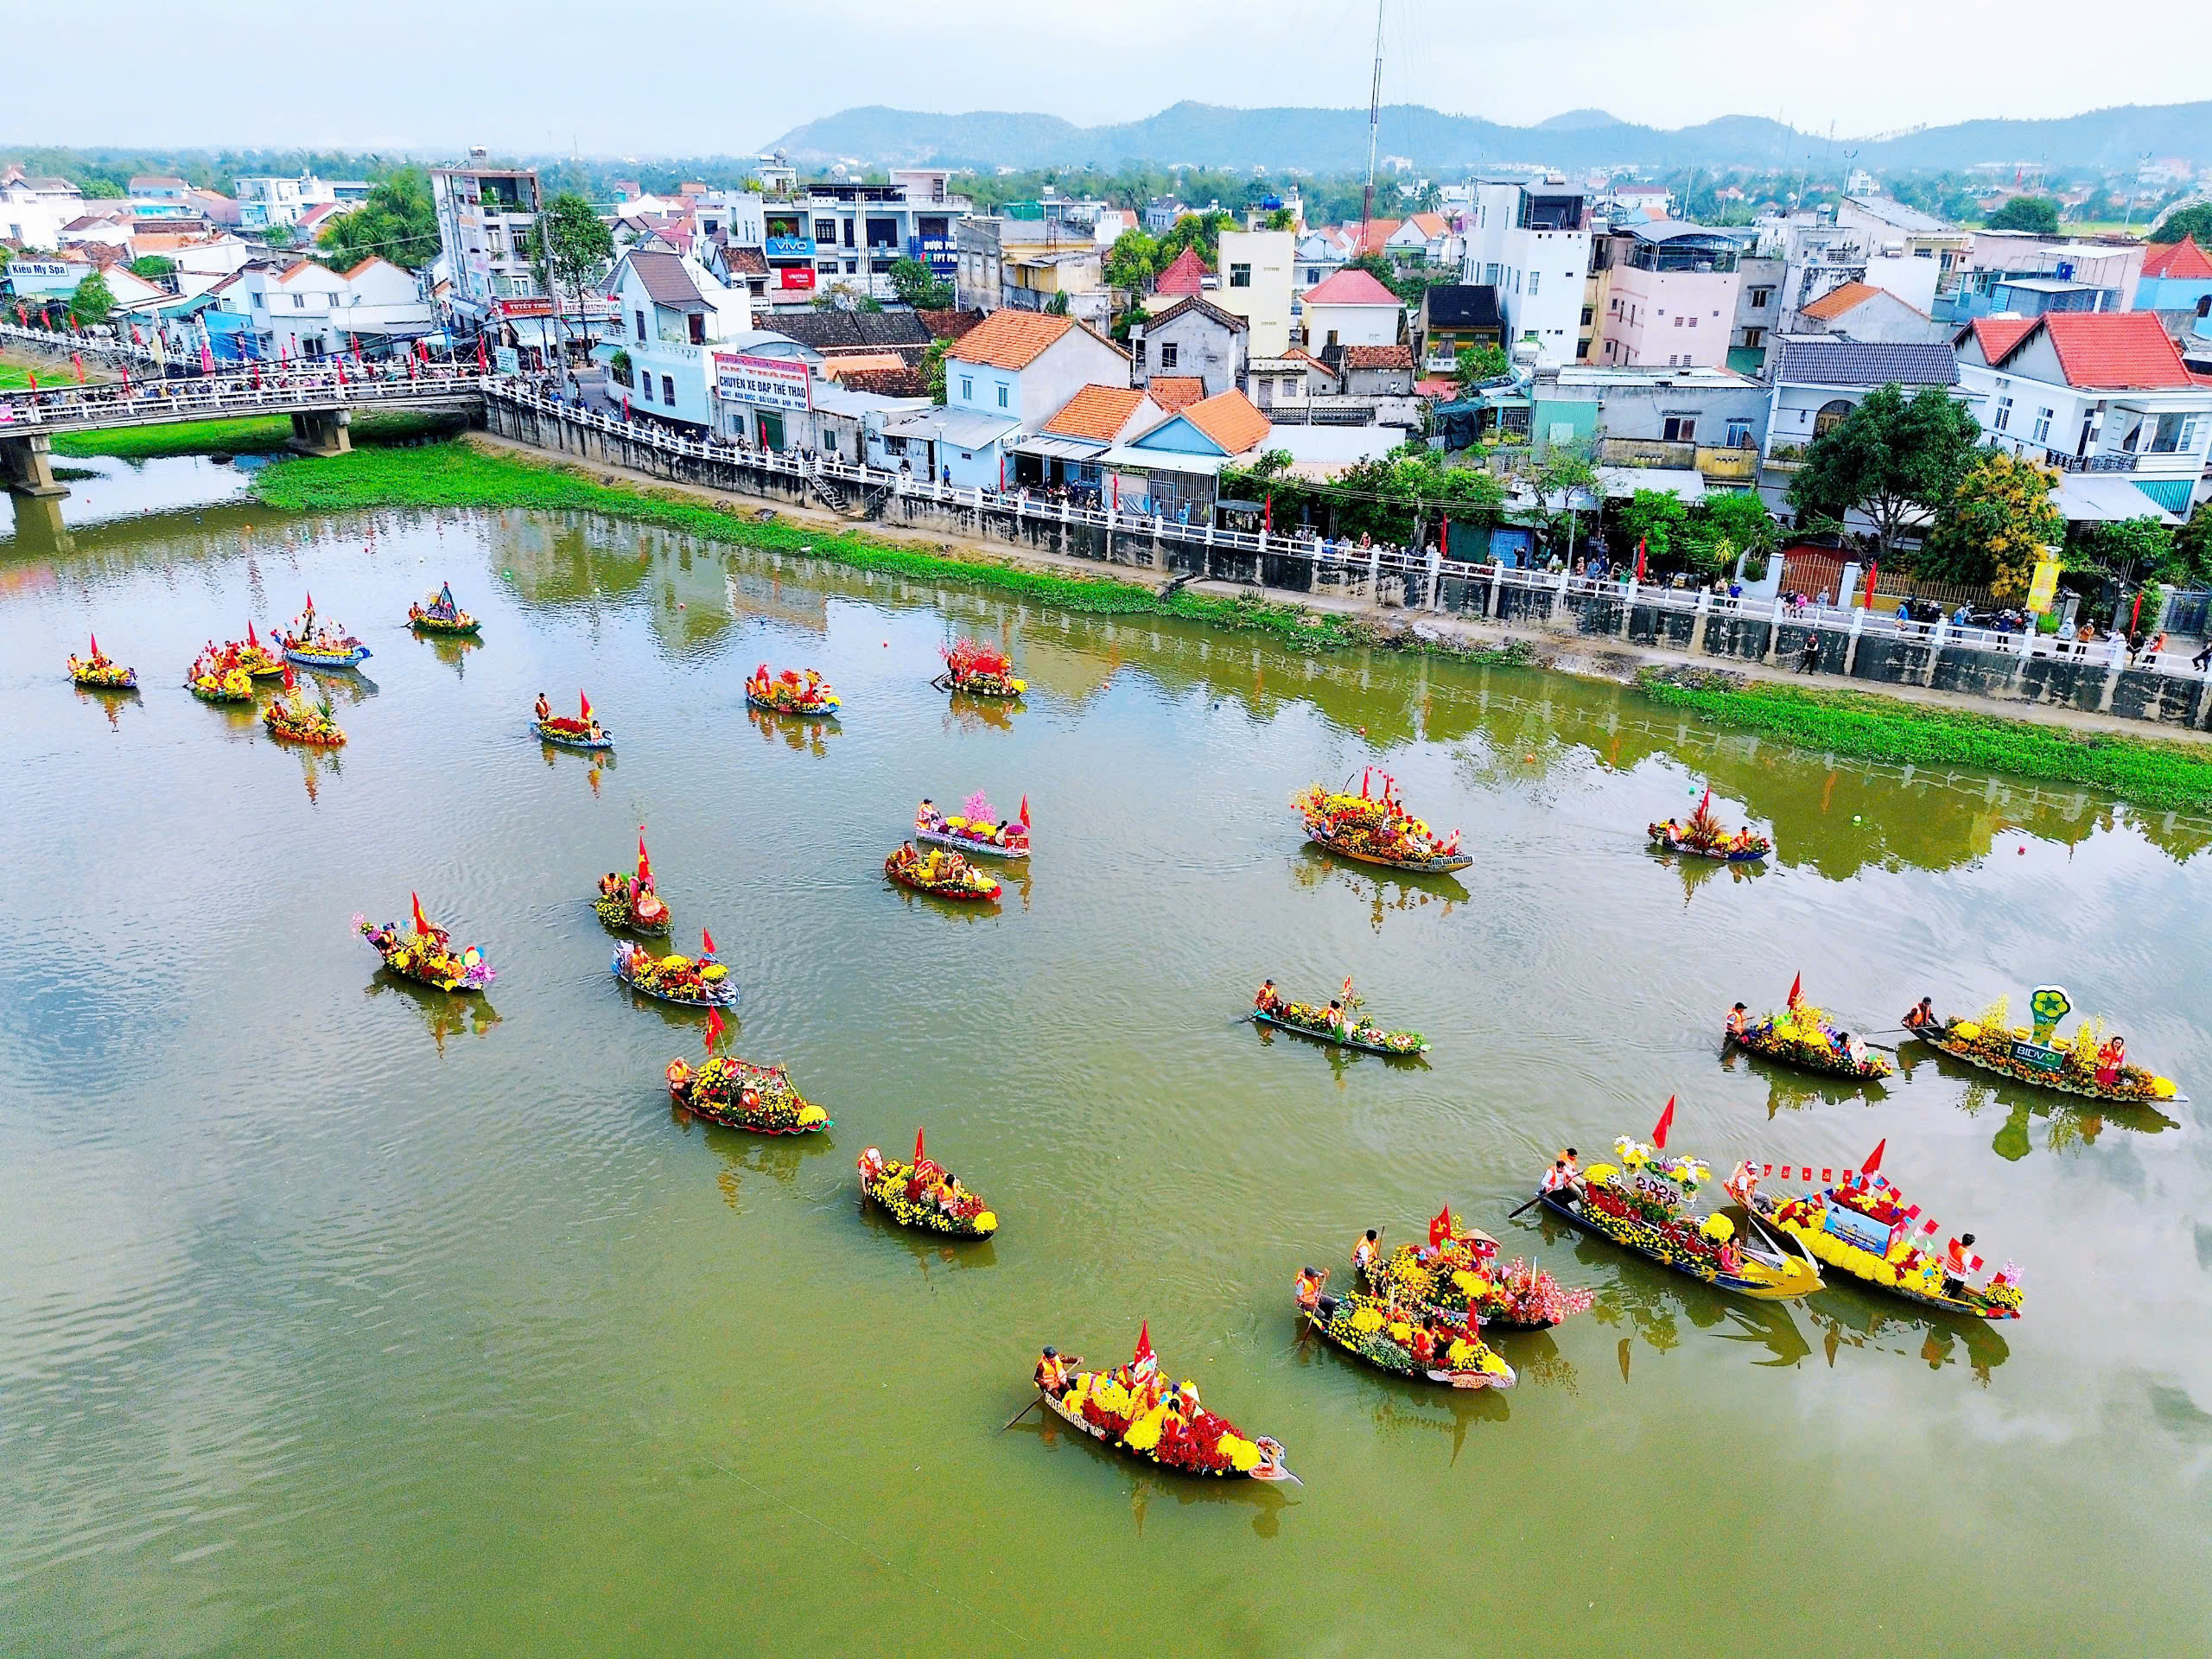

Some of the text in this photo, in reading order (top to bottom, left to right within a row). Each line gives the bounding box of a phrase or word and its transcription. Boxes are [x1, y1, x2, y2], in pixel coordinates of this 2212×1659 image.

[775, 239, 807, 251] vivo
[933, 253, 945, 263] FPT
[48, 264, 66, 275] Spa
[719, 375, 746, 390] CHUYÊN
[747, 379, 757, 391] XE
[788, 385, 806, 398] THAO
[2016, 1046, 2047, 1060] BIDV
[1636, 1176, 1678, 1205] 2025
